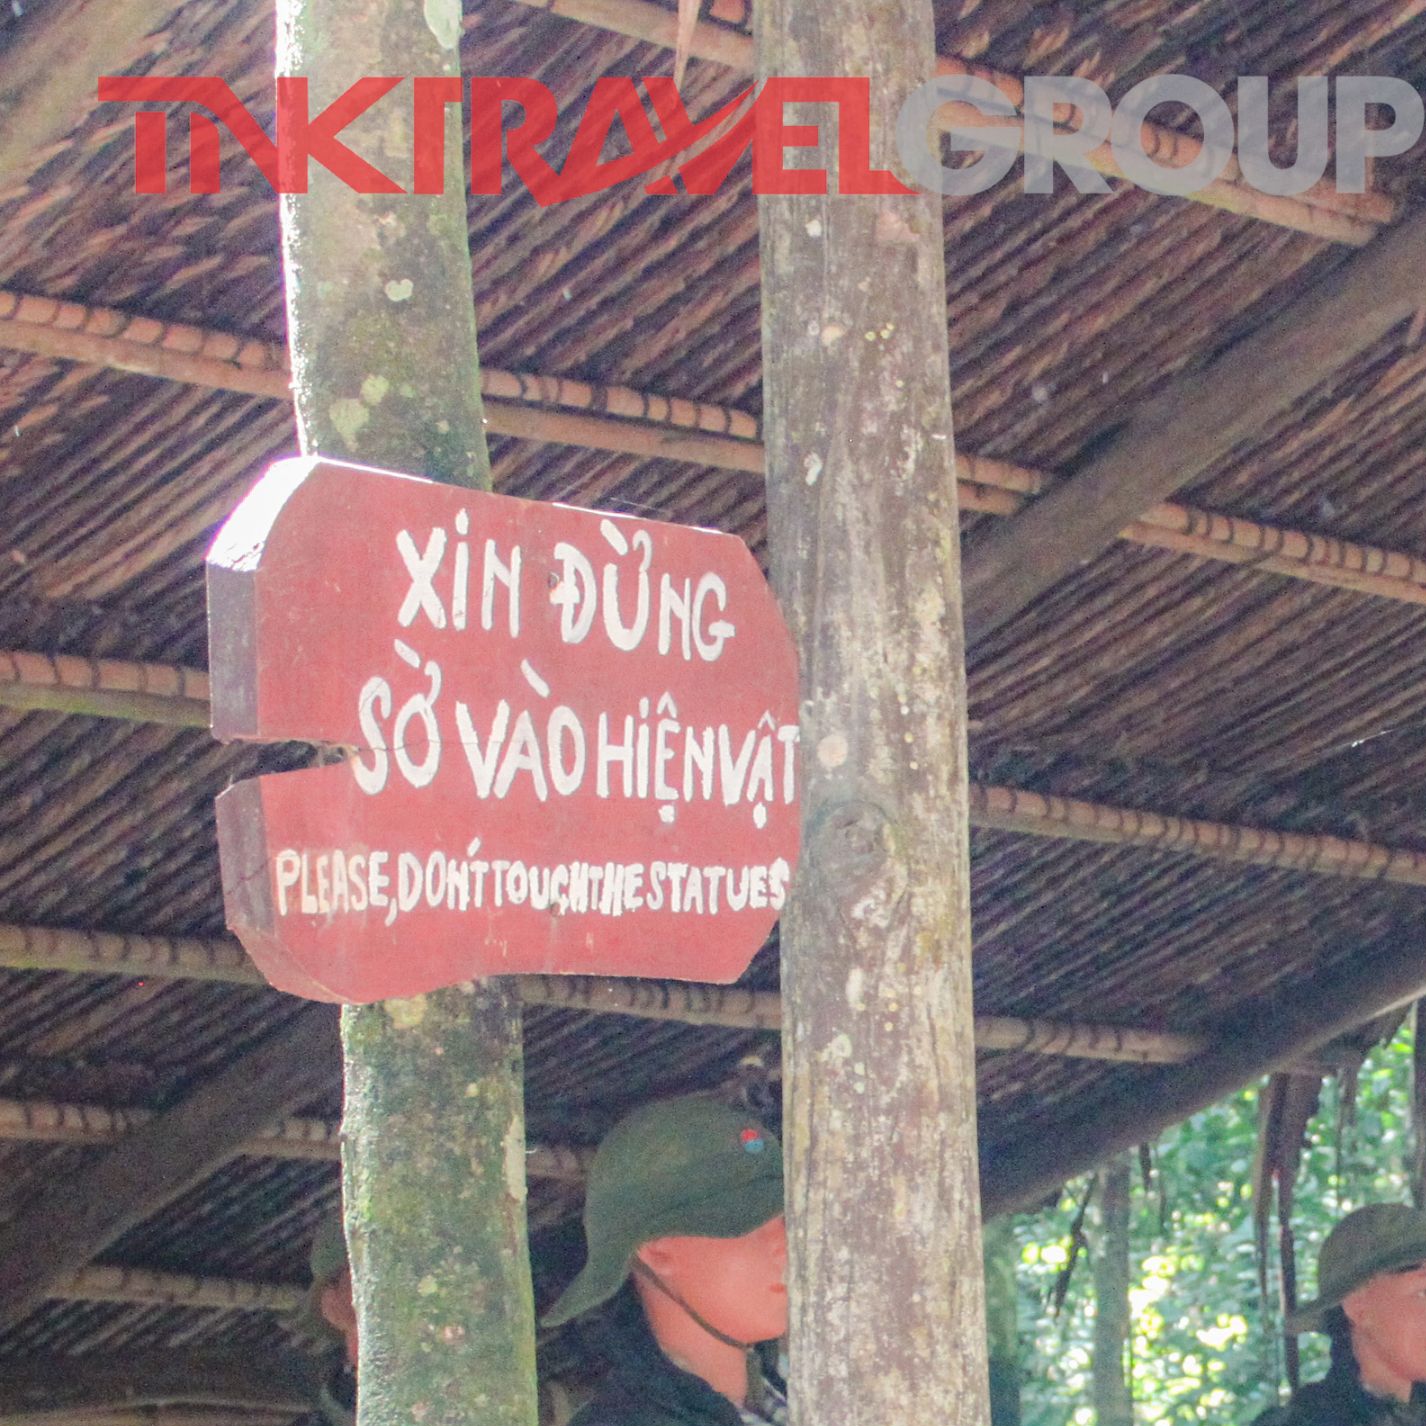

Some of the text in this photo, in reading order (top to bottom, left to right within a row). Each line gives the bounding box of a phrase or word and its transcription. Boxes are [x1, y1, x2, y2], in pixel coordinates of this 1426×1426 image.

[549, 518, 736, 662] ĐỪNG
[351, 638, 442, 796] SỜ
[455, 660, 587, 802] VÀO
[276, 848, 398, 927] PLEASE,
[646, 856, 791, 915] STATUES
